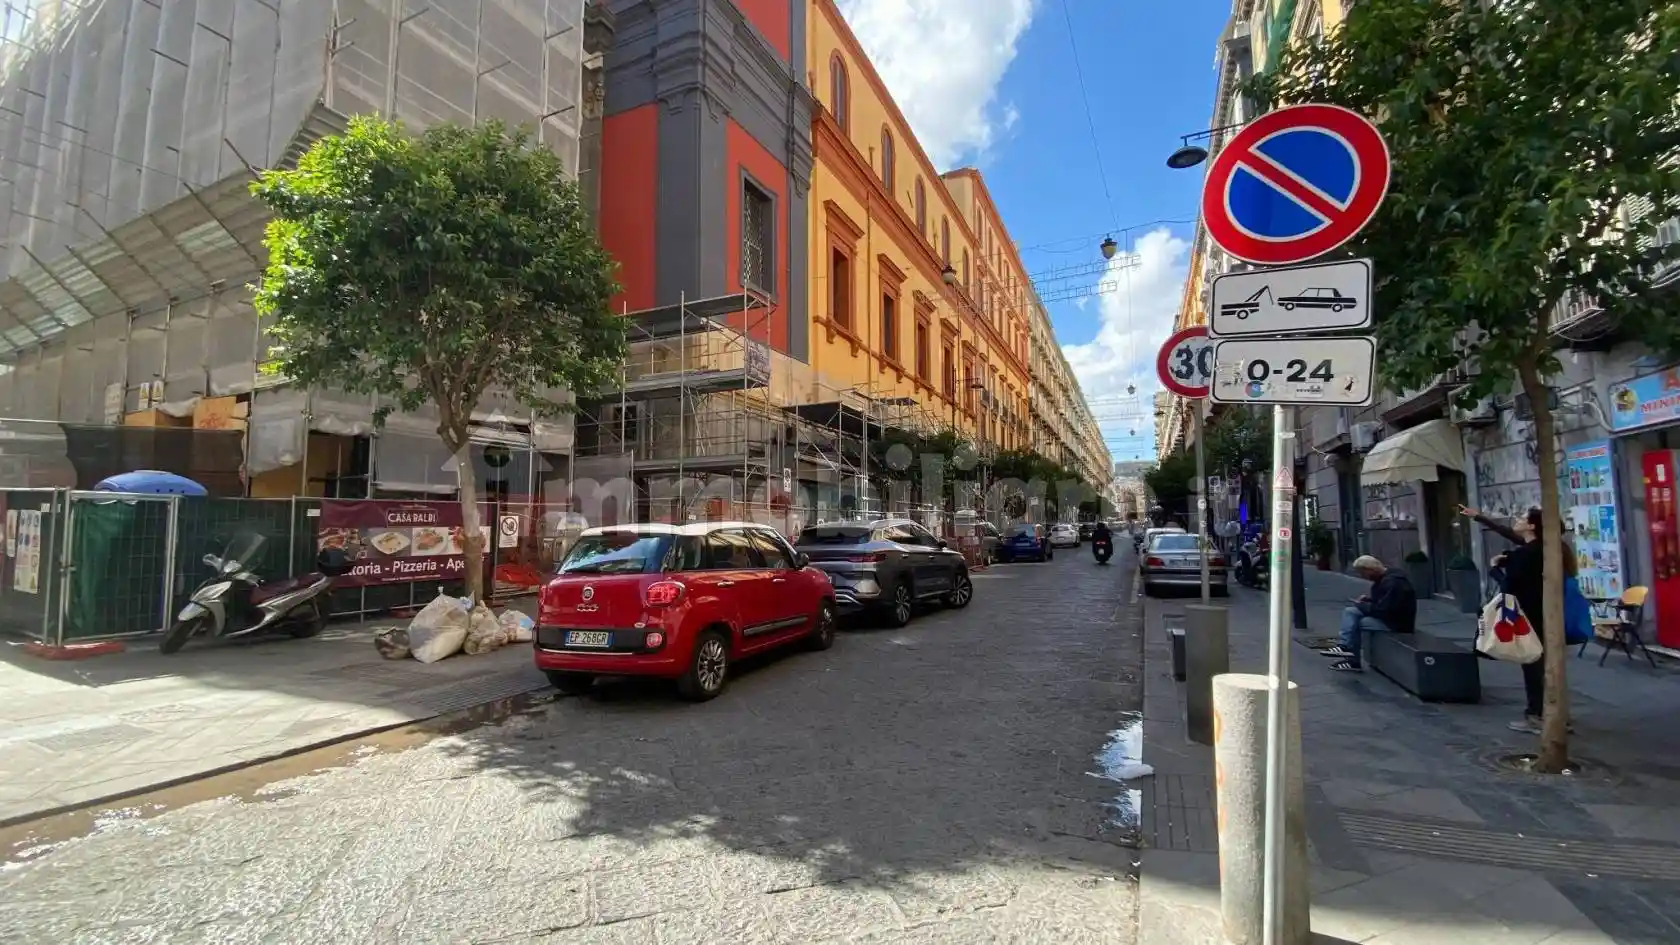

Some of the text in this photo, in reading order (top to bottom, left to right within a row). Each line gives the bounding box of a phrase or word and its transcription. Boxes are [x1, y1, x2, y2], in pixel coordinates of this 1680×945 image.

[1175, 345, 1213, 379] 30
[1247, 358, 1334, 383] 0-24
[392, 559, 437, 573] Pizzeria
